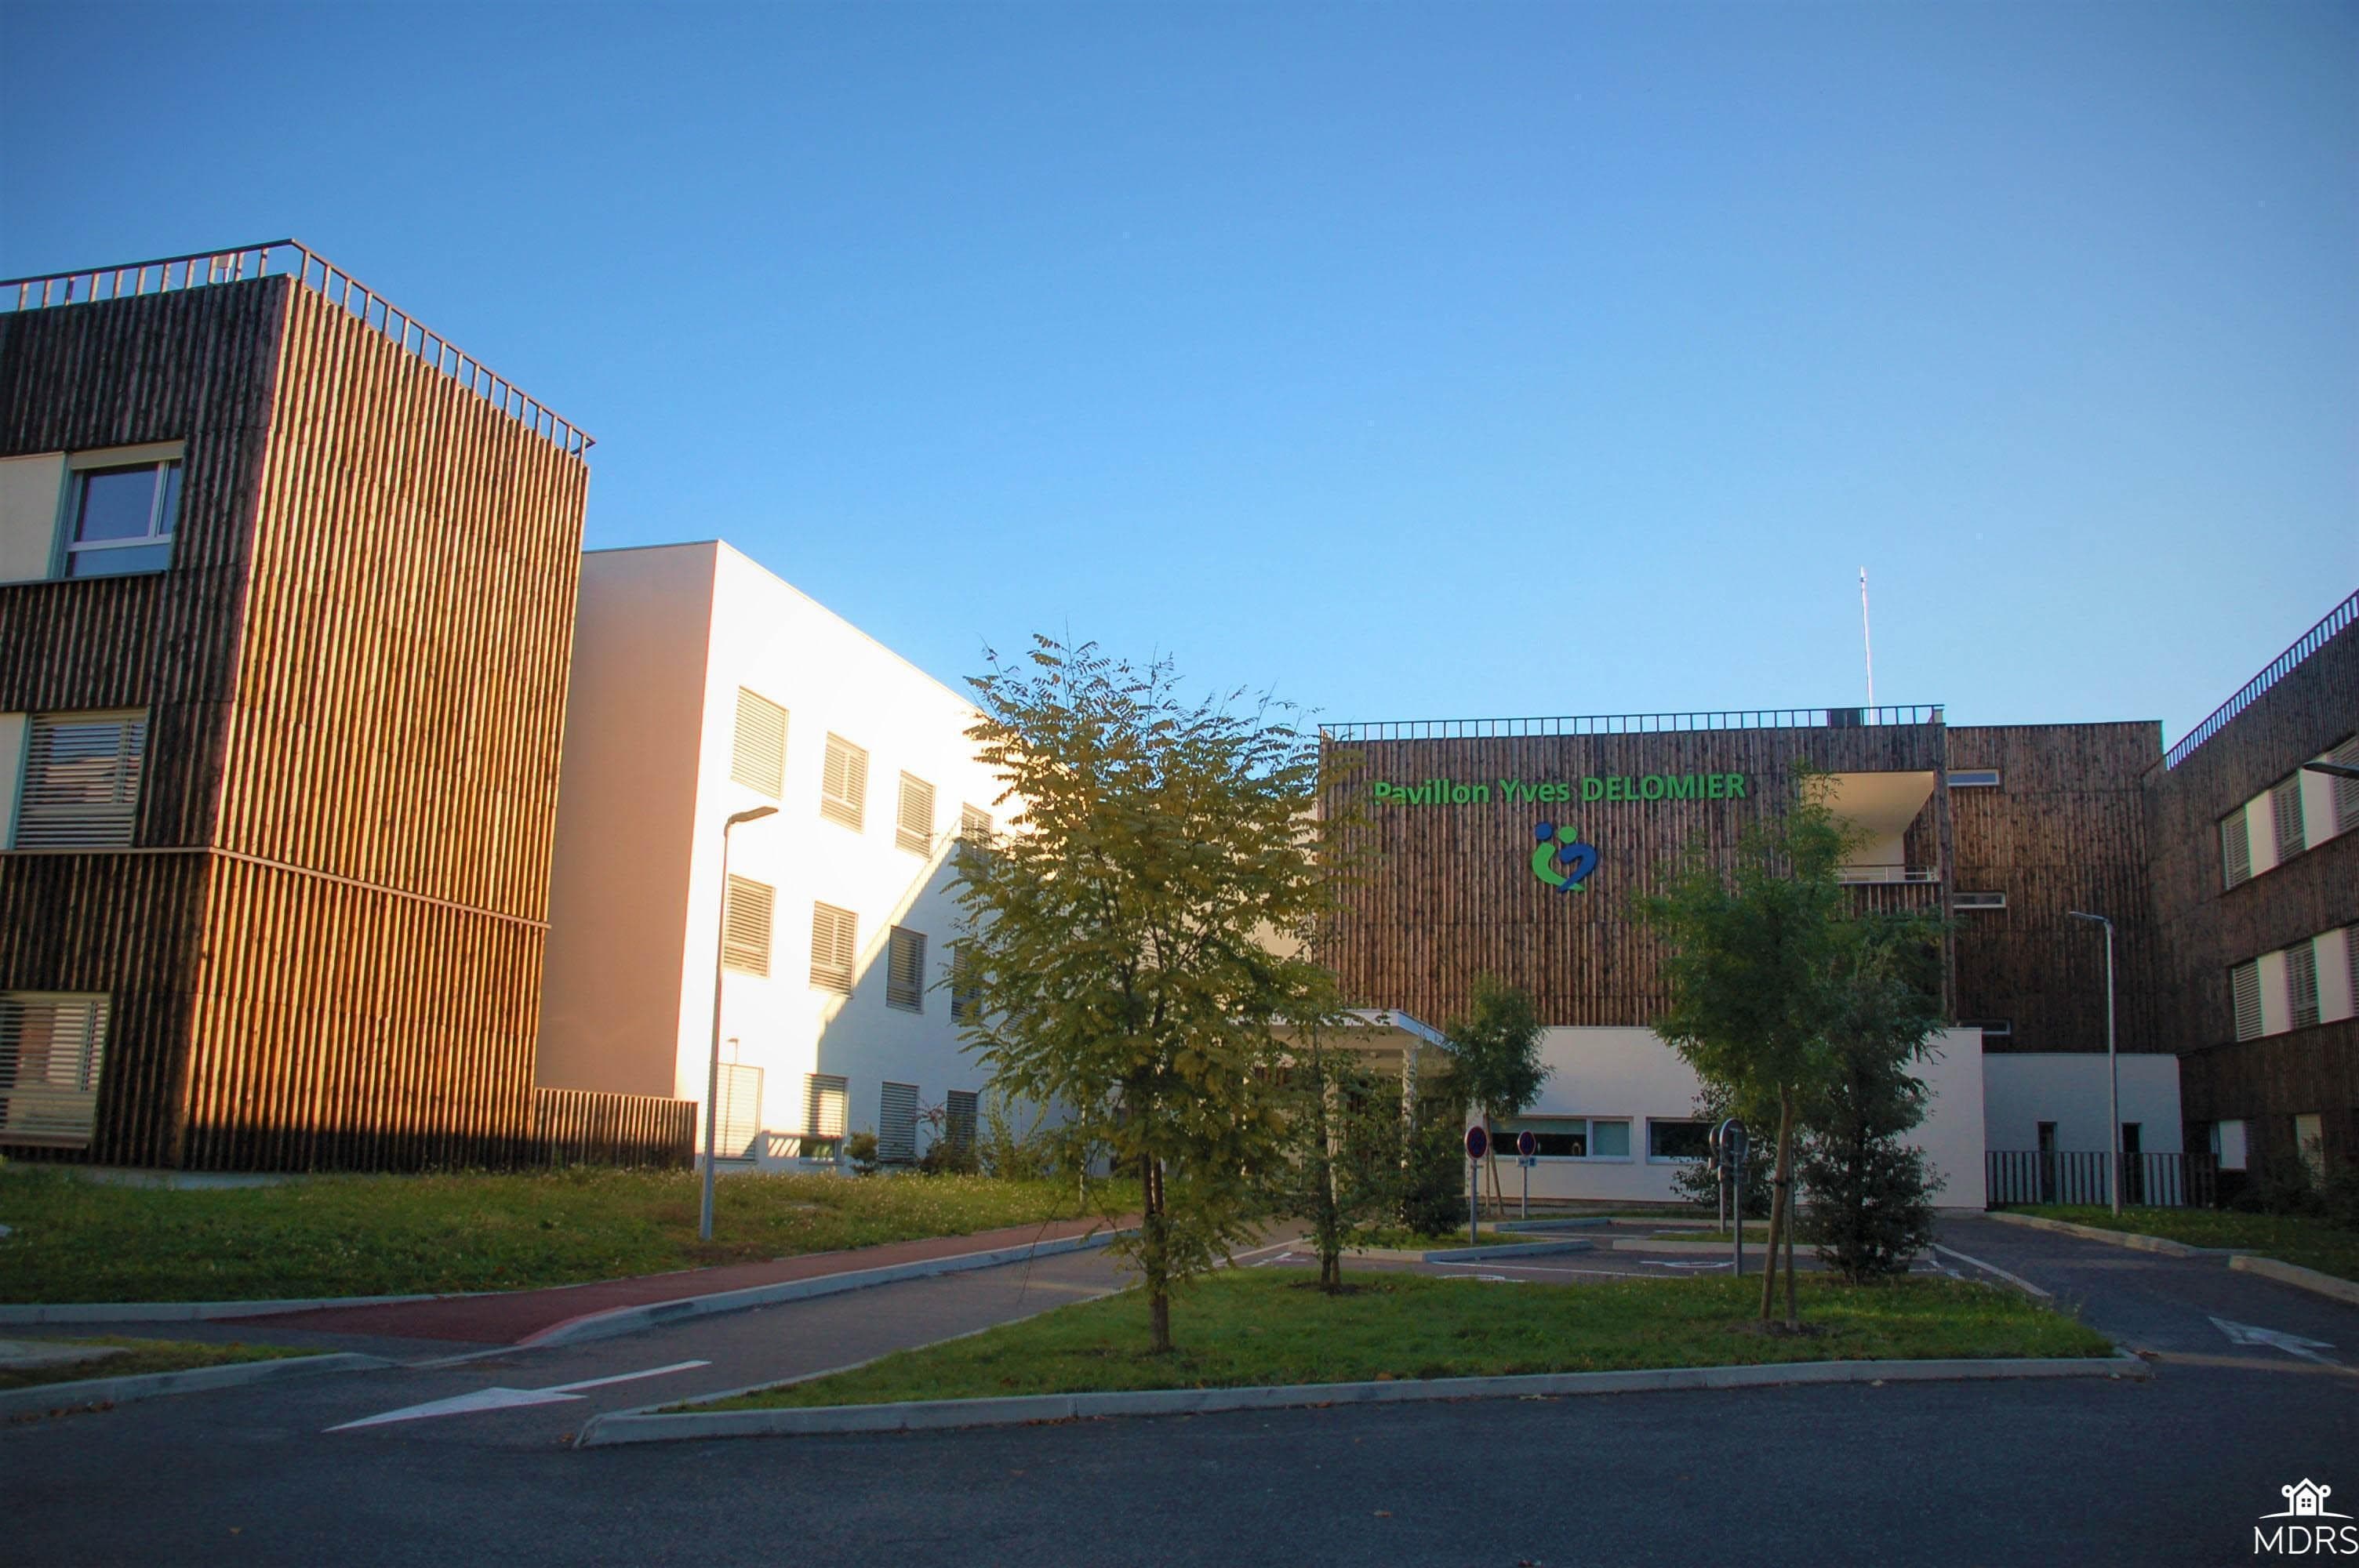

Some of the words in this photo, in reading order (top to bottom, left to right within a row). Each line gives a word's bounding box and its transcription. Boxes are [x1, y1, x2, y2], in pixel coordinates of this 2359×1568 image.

[1374, 779, 1489, 805] Pavillon
[1499, 779, 1570, 803] Yves
[1582, 773, 1746, 801] DELOMIER
